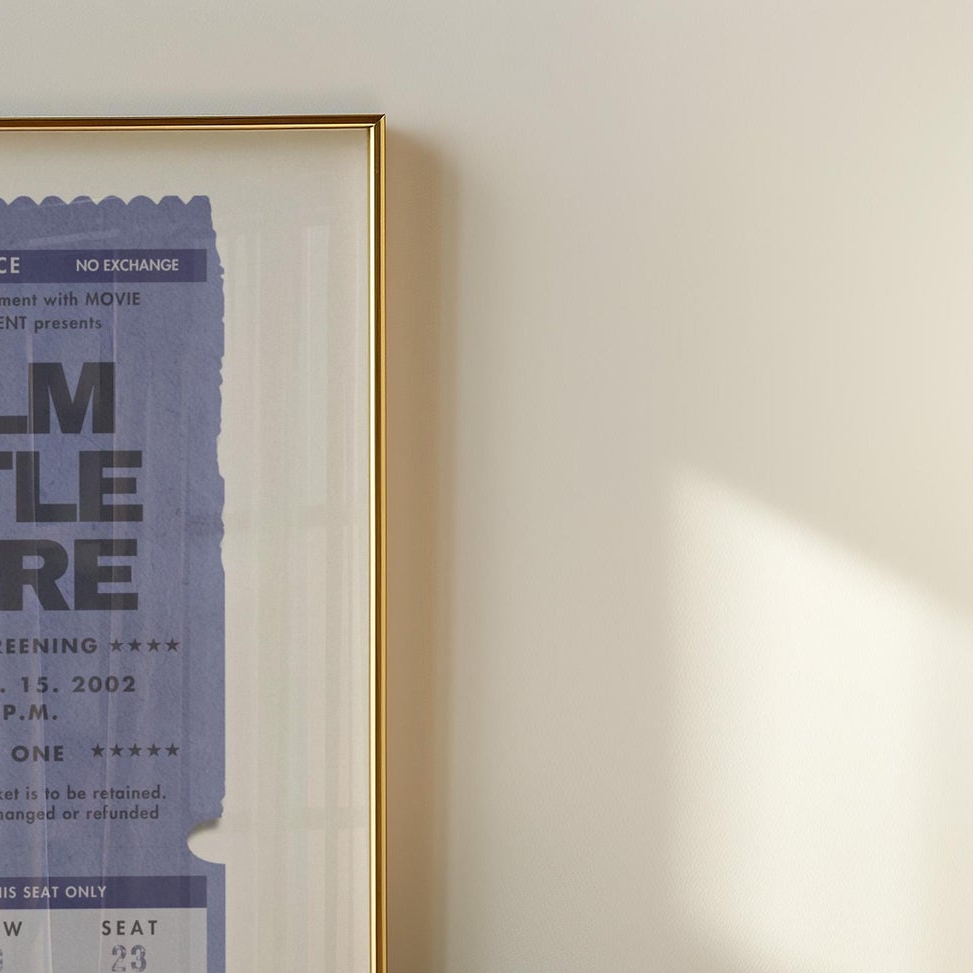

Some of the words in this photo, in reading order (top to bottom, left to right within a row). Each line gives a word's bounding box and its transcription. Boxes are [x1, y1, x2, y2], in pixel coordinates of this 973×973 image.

[75, 259, 100, 272] NO
[103, 258, 179, 272] EXCHANGE
[43, 292, 79, 307] with
[84, 291, 140, 306] MOVIE
[34, 316, 102, 333] presents
[20, 676, 60, 693] 15.
[72, 676, 137, 693] 2002
[3, 704, 59, 721] P.M.
[11, 745, 65, 762] ONE
[25, 787, 39, 800] is
[44, 787, 57, 800] to
[62, 786, 87, 800] be
[92, 785, 167, 800] retained.
[62, 808, 80, 820] or
[86, 805, 159, 820] refunded
[23, 886, 61, 899] SEAT
[65, 885, 107, 899] ONLY
[102, 920, 158, 936] SEAT
[111, 944, 148, 973] 23
